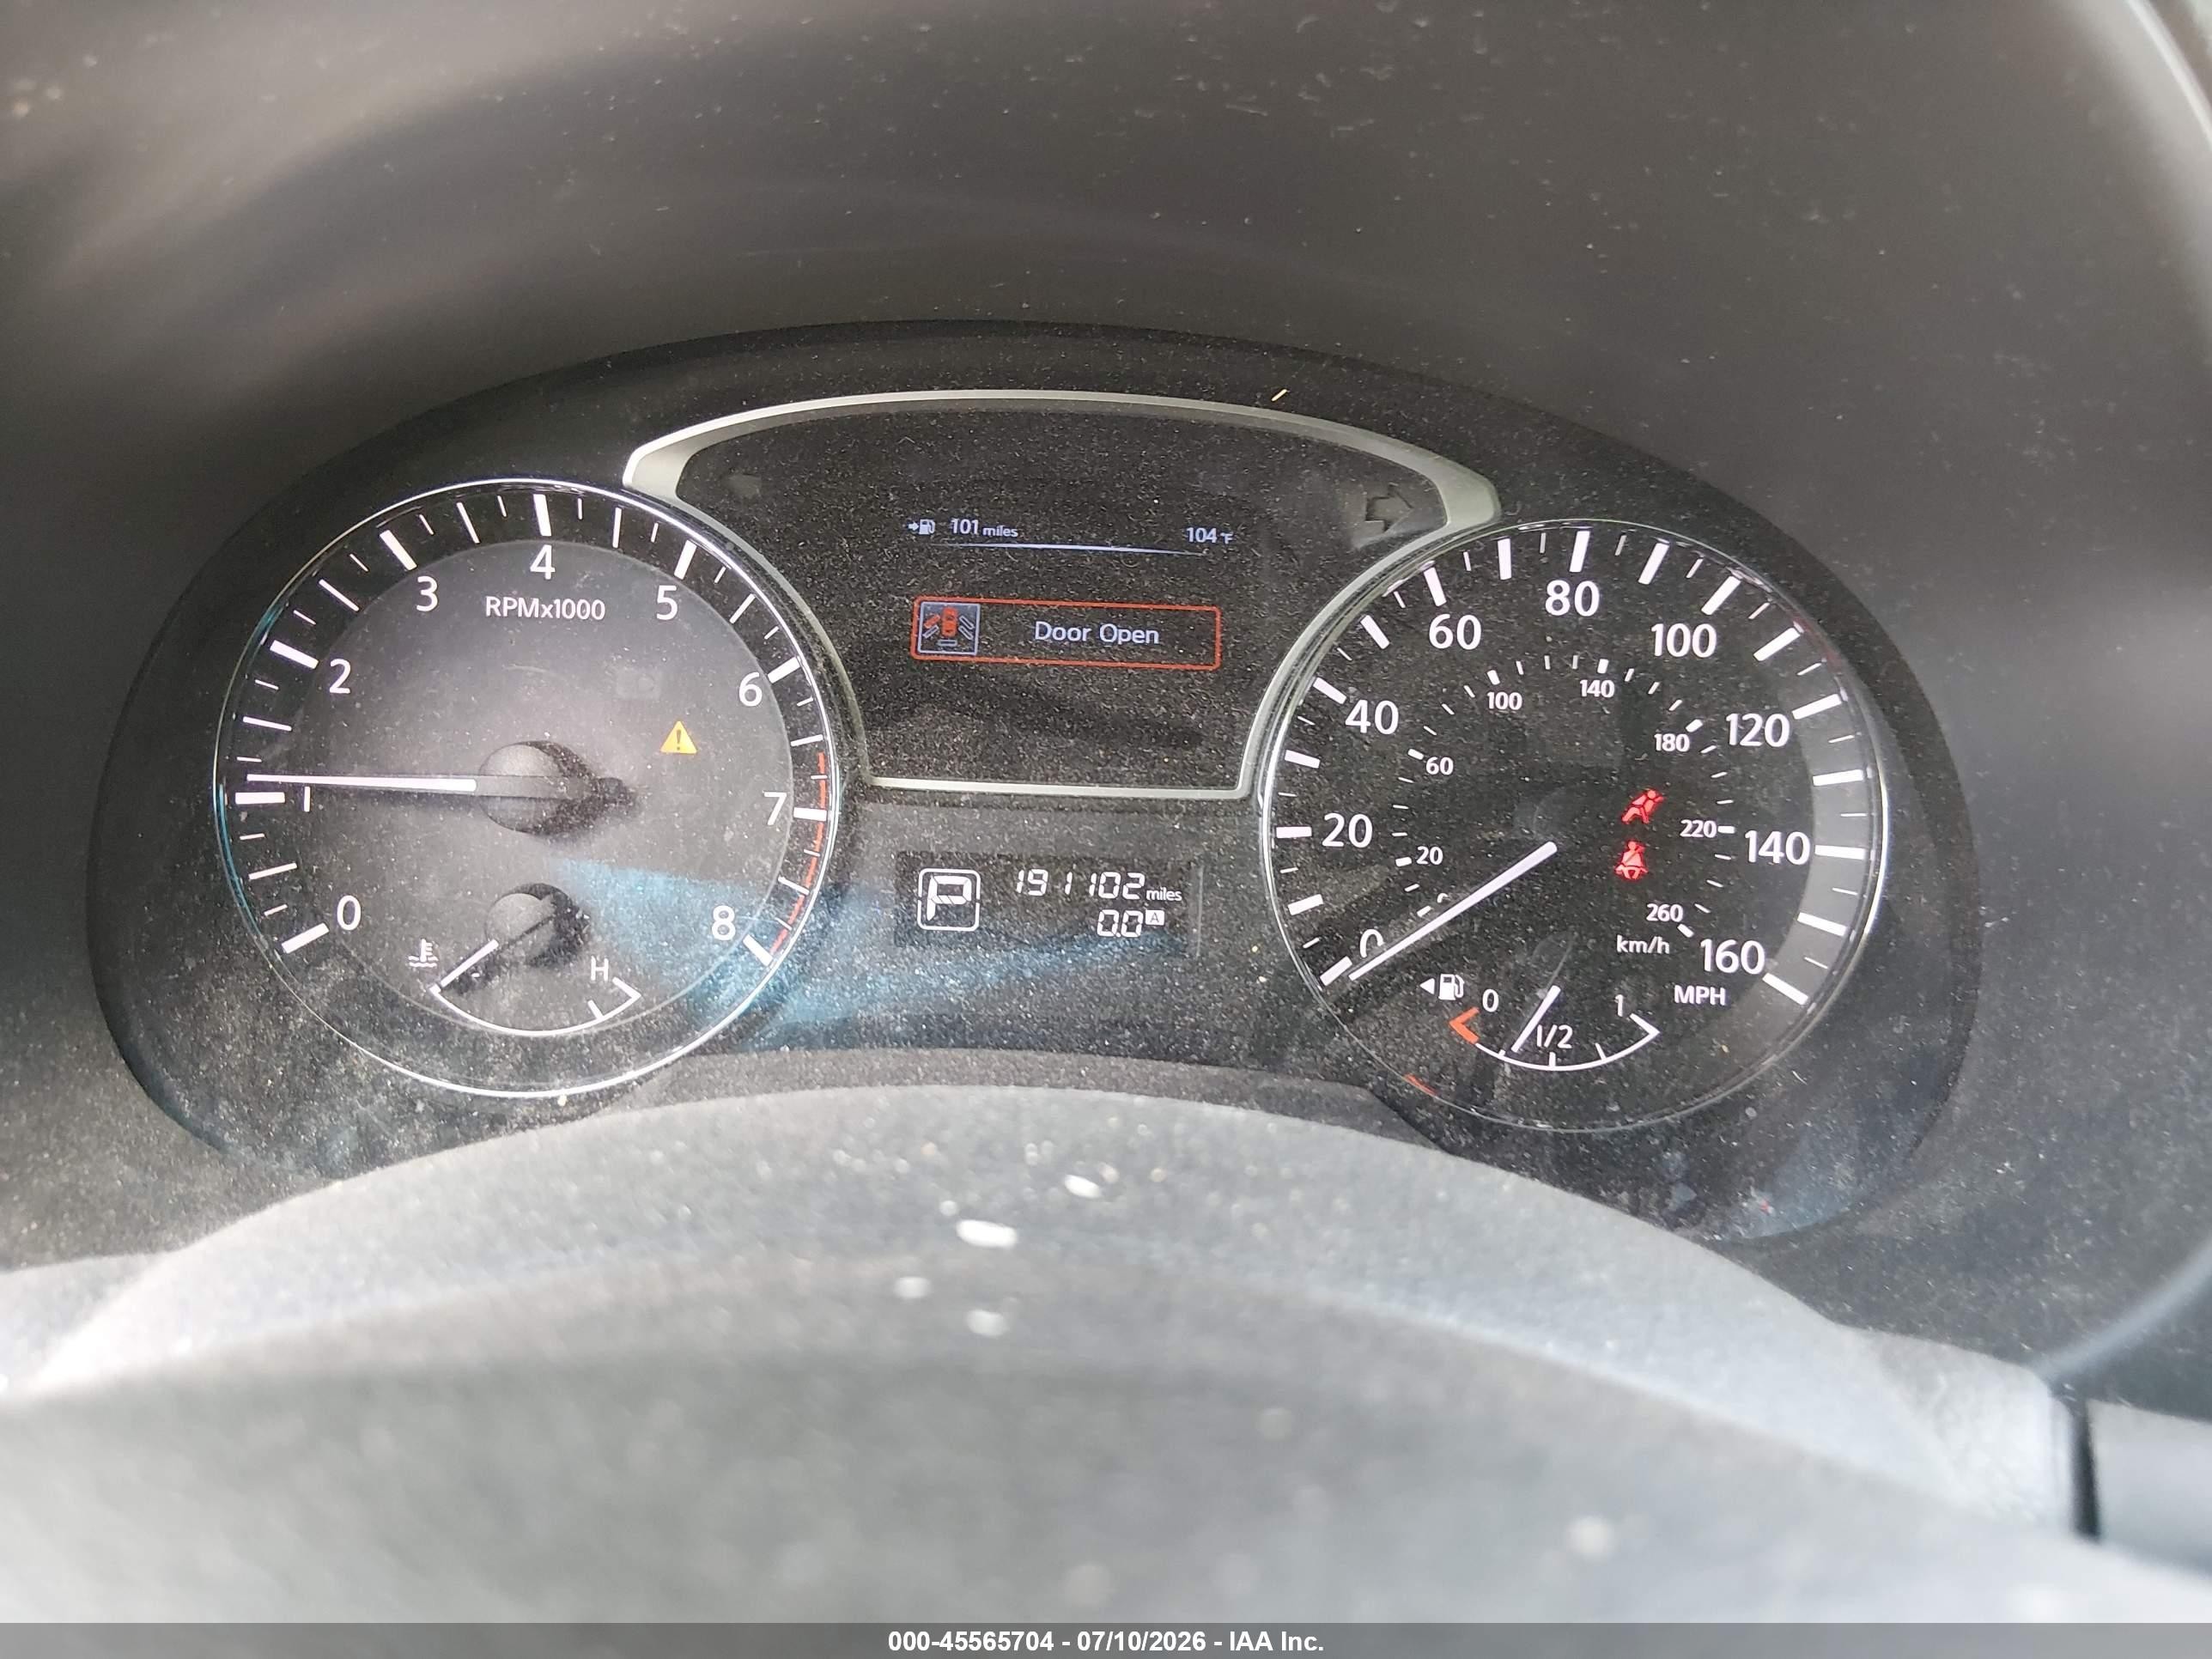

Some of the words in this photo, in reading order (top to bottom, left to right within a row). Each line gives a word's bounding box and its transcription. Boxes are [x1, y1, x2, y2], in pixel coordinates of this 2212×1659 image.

[951, 519, 979, 535] 101
[982, 524, 1018, 538] miles
[1187, 527, 1217, 544] 104
[530, 544, 555, 580] 4
[417, 576, 439, 612] 3
[485, 597, 605, 620] RPMx1000
[657, 585, 678, 620] 5
[1546, 580, 1599, 616] 80
[1035, 622, 1092, 641] Door
[1099, 624, 1158, 646] Open
[1429, 615, 1481, 649] 60
[1651, 623, 1716, 659] 100
[329, 658, 351, 694] 2
[738, 672, 762, 707] 6
[1580, 679, 1614, 698] 140
[1487, 691, 1522, 710] 100
[1345, 700, 1398, 734] 40
[1726, 714, 1790, 748] 120
[1655, 733, 1690, 752] 180
[1425, 757, 1453, 775] 60
[763, 792, 787, 825] 7
[1322, 813, 1372, 848] 20
[1680, 819, 1717, 838] 220
[1417, 846, 1443, 866] 20
[1744, 830, 1810, 865] 140
[927, 875, 969, 921] P
[1016, 870, 1145, 899] 191102
[1146, 887, 1182, 902] miles
[337, 896, 362, 931] 0
[712, 905, 735, 940] 8
[1097, 910, 1143, 938] 0.0
[1647, 903, 1683, 922] 260
[1616, 934, 1669, 955] km/h
[1700, 939, 1765, 975] 160
[591, 959, 609, 981] H
[1482, 989, 1498, 1012] 0
[1614, 994, 1624, 1017] 1
[1674, 985, 1726, 1006] MPH
[1537, 1025, 1572, 1048] 1/2
